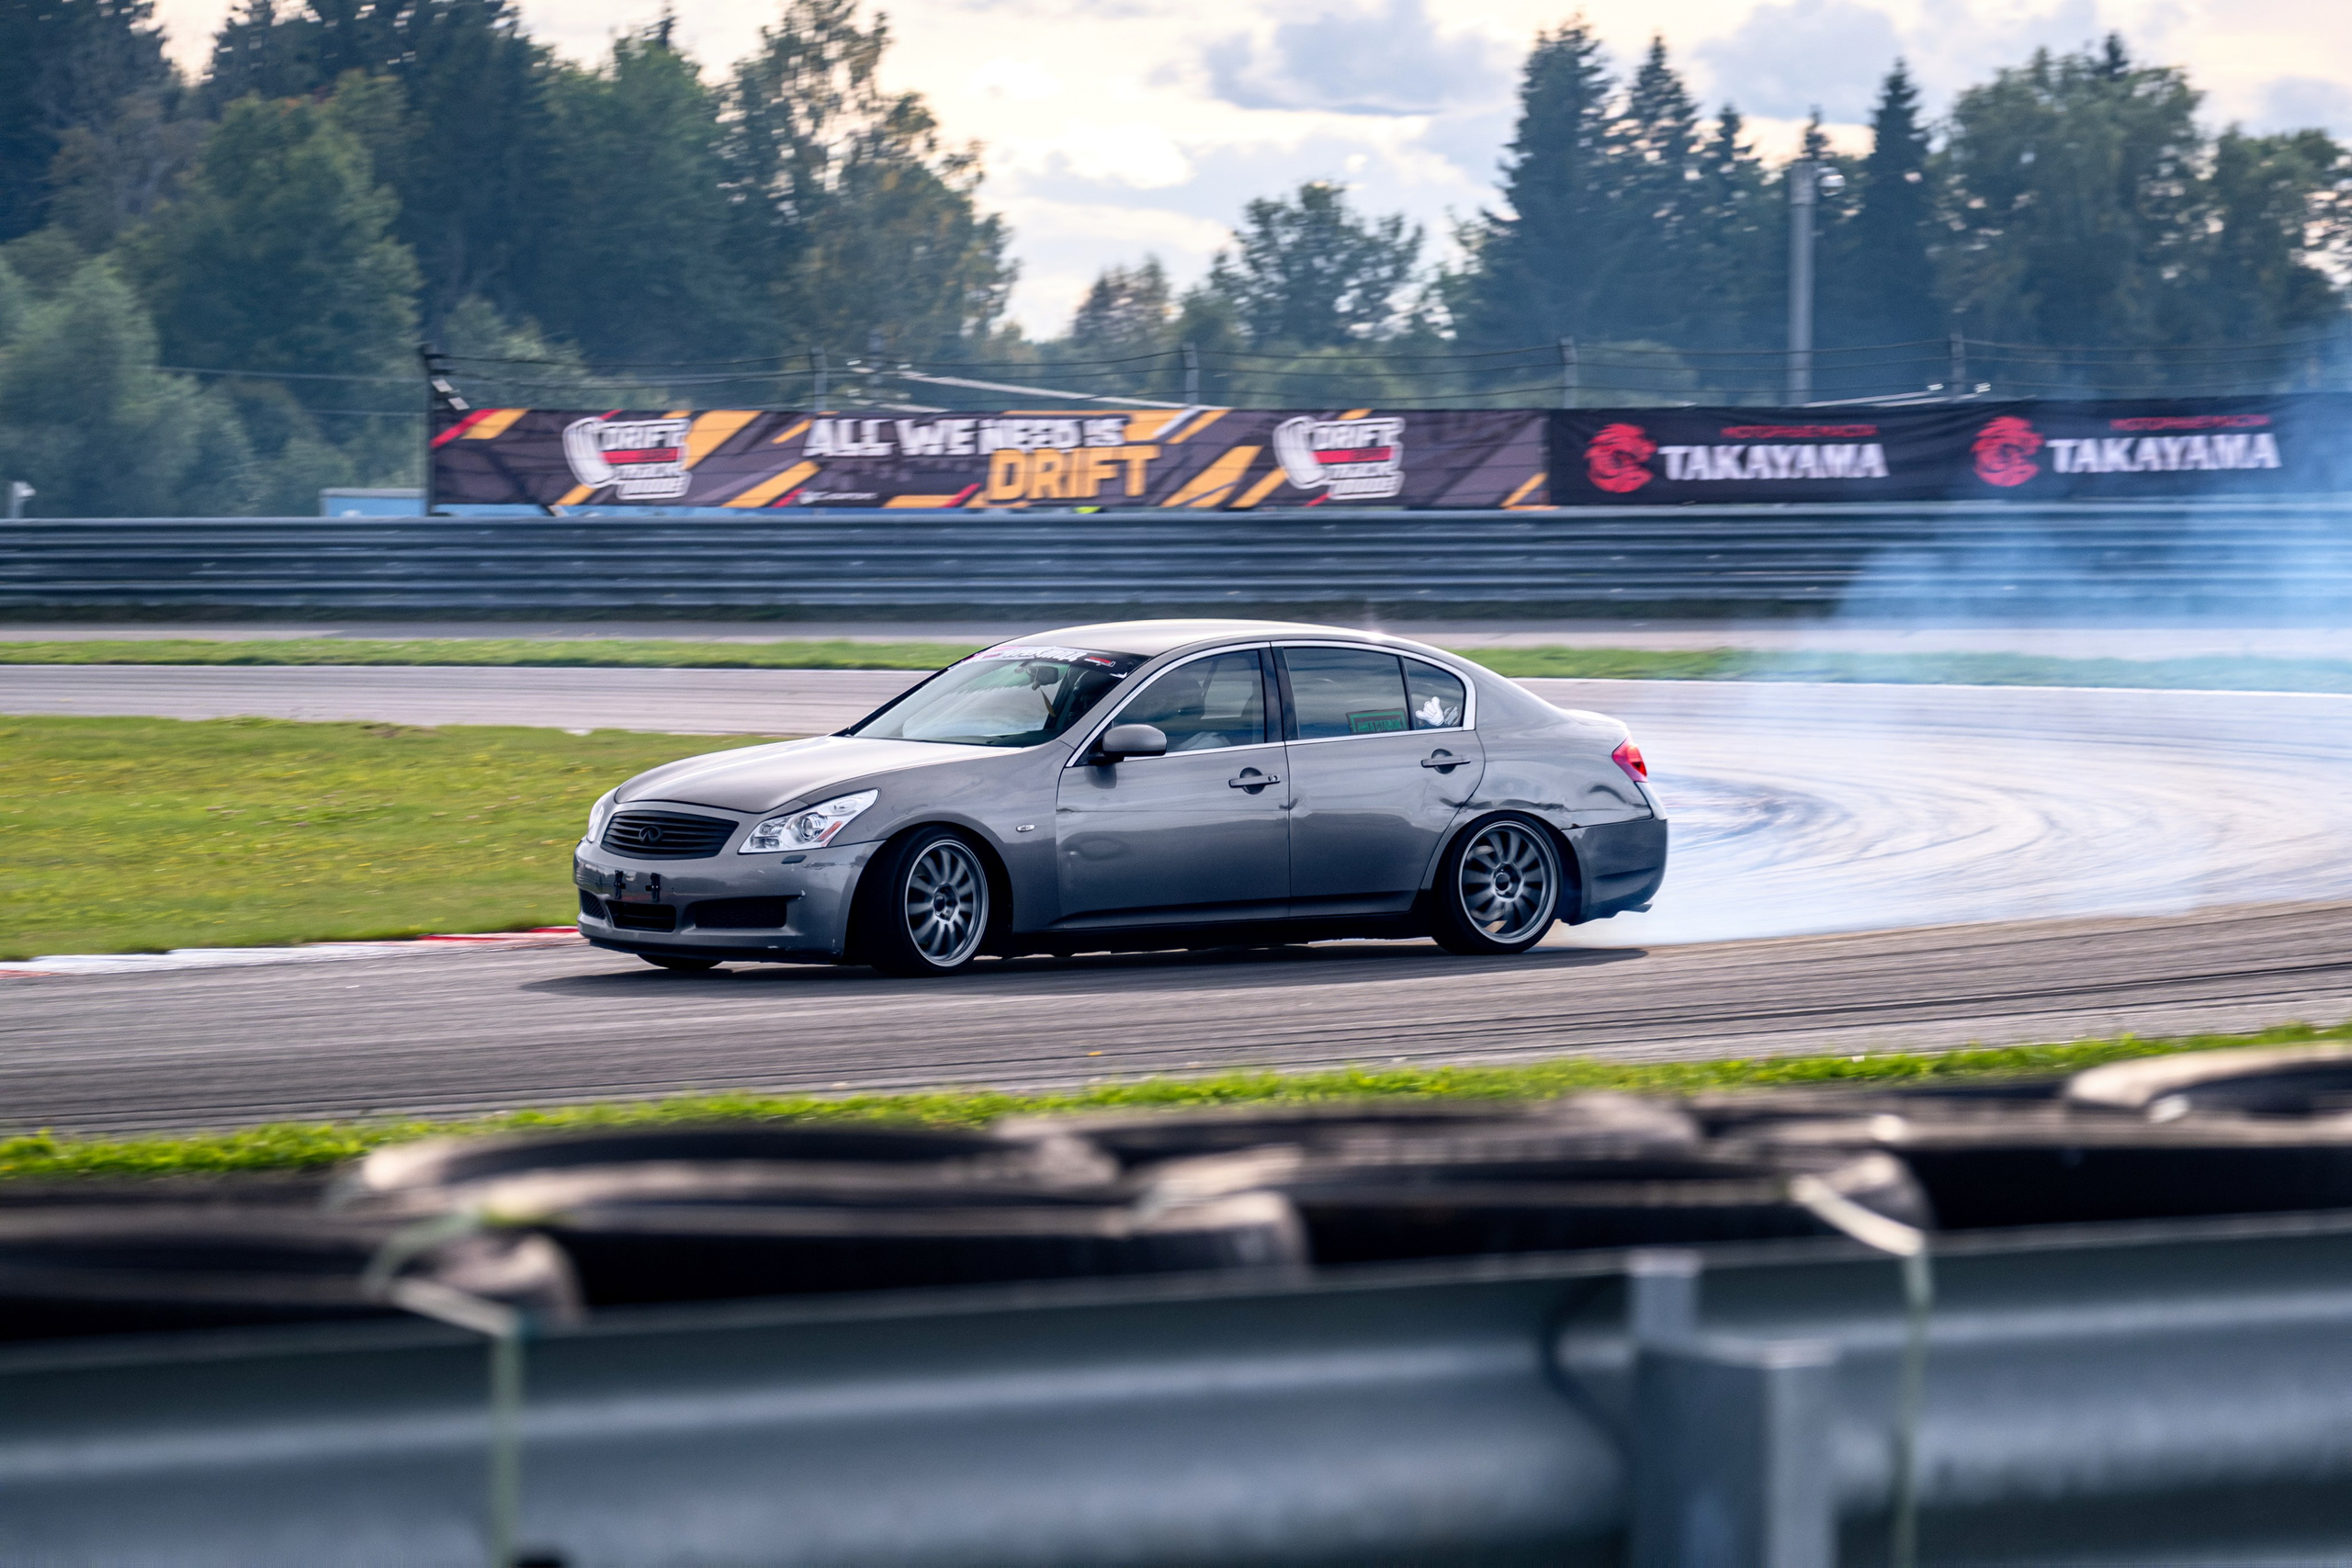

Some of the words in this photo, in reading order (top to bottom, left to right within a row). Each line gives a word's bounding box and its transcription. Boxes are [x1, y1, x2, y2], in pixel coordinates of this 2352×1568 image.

[801, 418, 893, 457] ALL
[894, 418, 977, 457] WE
[978, 418, 1081, 454] NEED
[1083, 418, 1125, 446] IS
[1305, 423, 1402, 451] DRIFT
[2045, 433, 2283, 473] TAKAYAMA
[986, 445, 1161, 501] DRIFT
[1657, 443, 1890, 480] TAKAYAMA
